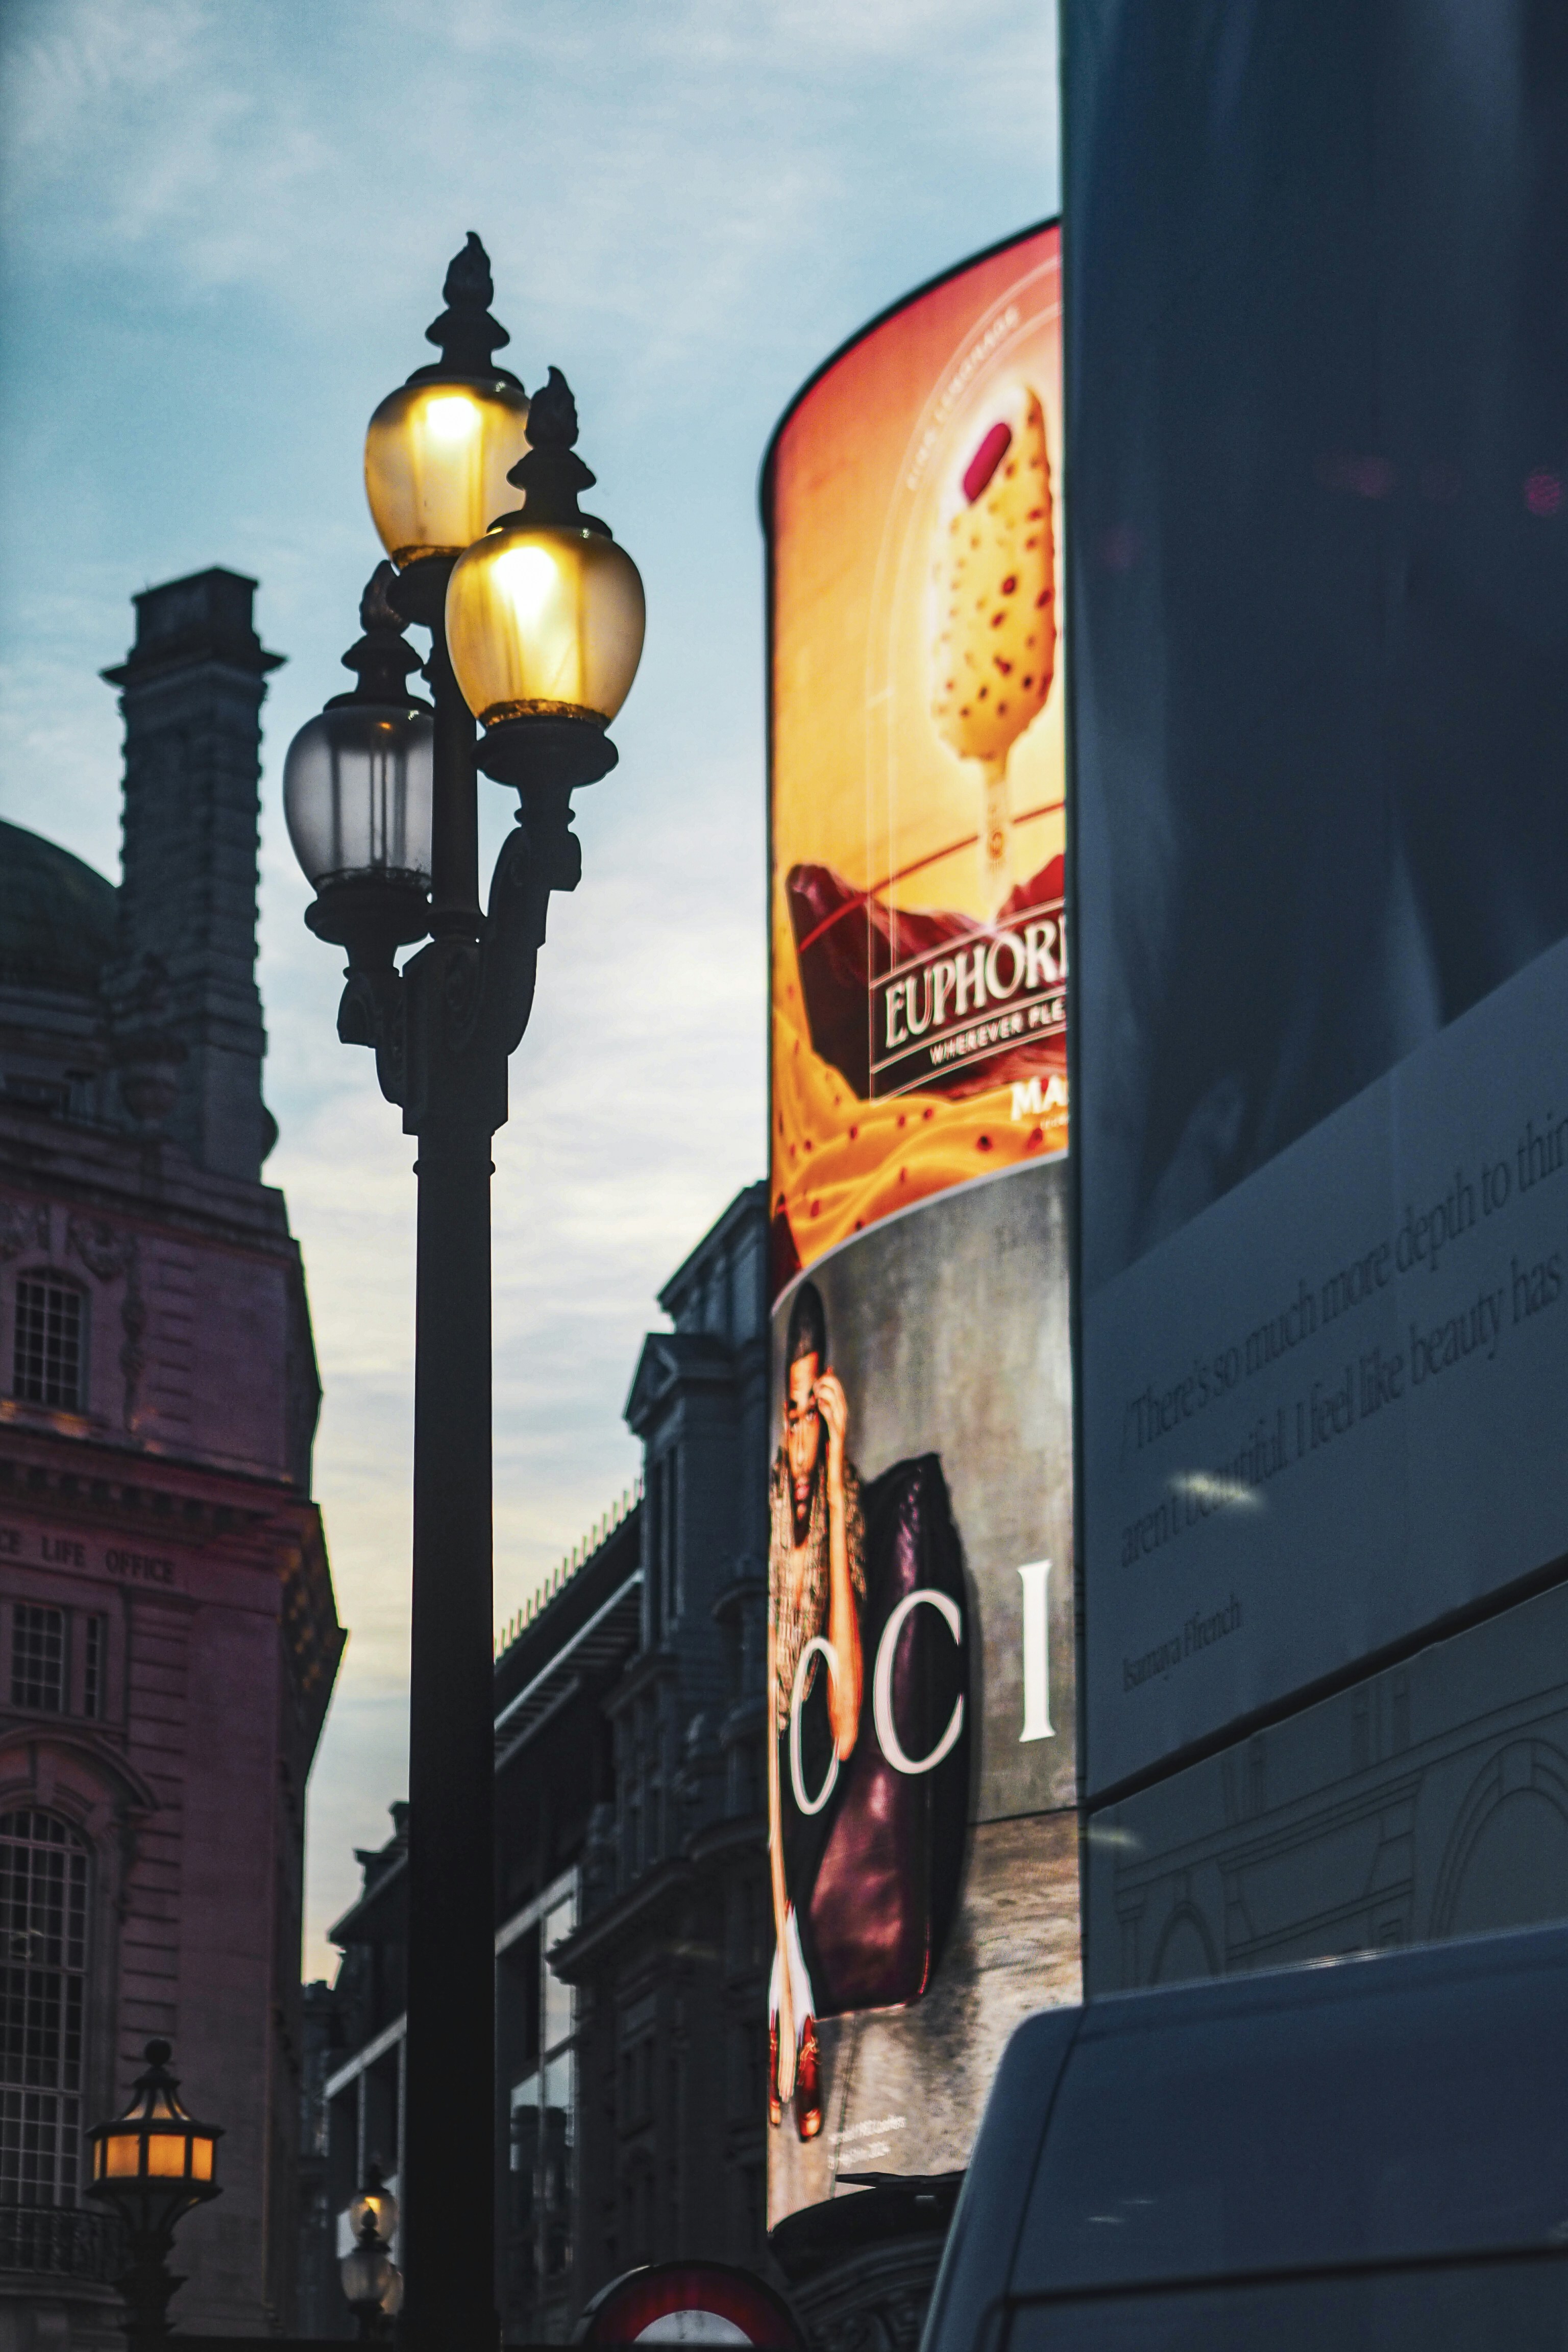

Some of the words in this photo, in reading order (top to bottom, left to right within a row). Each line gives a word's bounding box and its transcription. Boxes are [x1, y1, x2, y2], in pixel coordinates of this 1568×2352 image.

[929, 1011, 1022, 1066] WHEREVER
[1131, 1359, 1210, 1449] There's
[1213, 1344, 1241, 1397] so
[1244, 1278, 1317, 1377] much
[1321, 1242, 1391, 1325] more
[1395, 1170, 1477, 1270] depth
[1481, 1160, 1510, 1215] to
[1295, 1402, 1305, 1458] I
[1310, 1365, 1356, 1450] feel
[1359, 1345, 1405, 1419] like
[1409, 1287, 1504, 1387] beauty
[1510, 1253, 1562, 1325] has
[41, 1535, 86, 1567] LIFE
[105, 1548, 176, 1584] OFFICE
